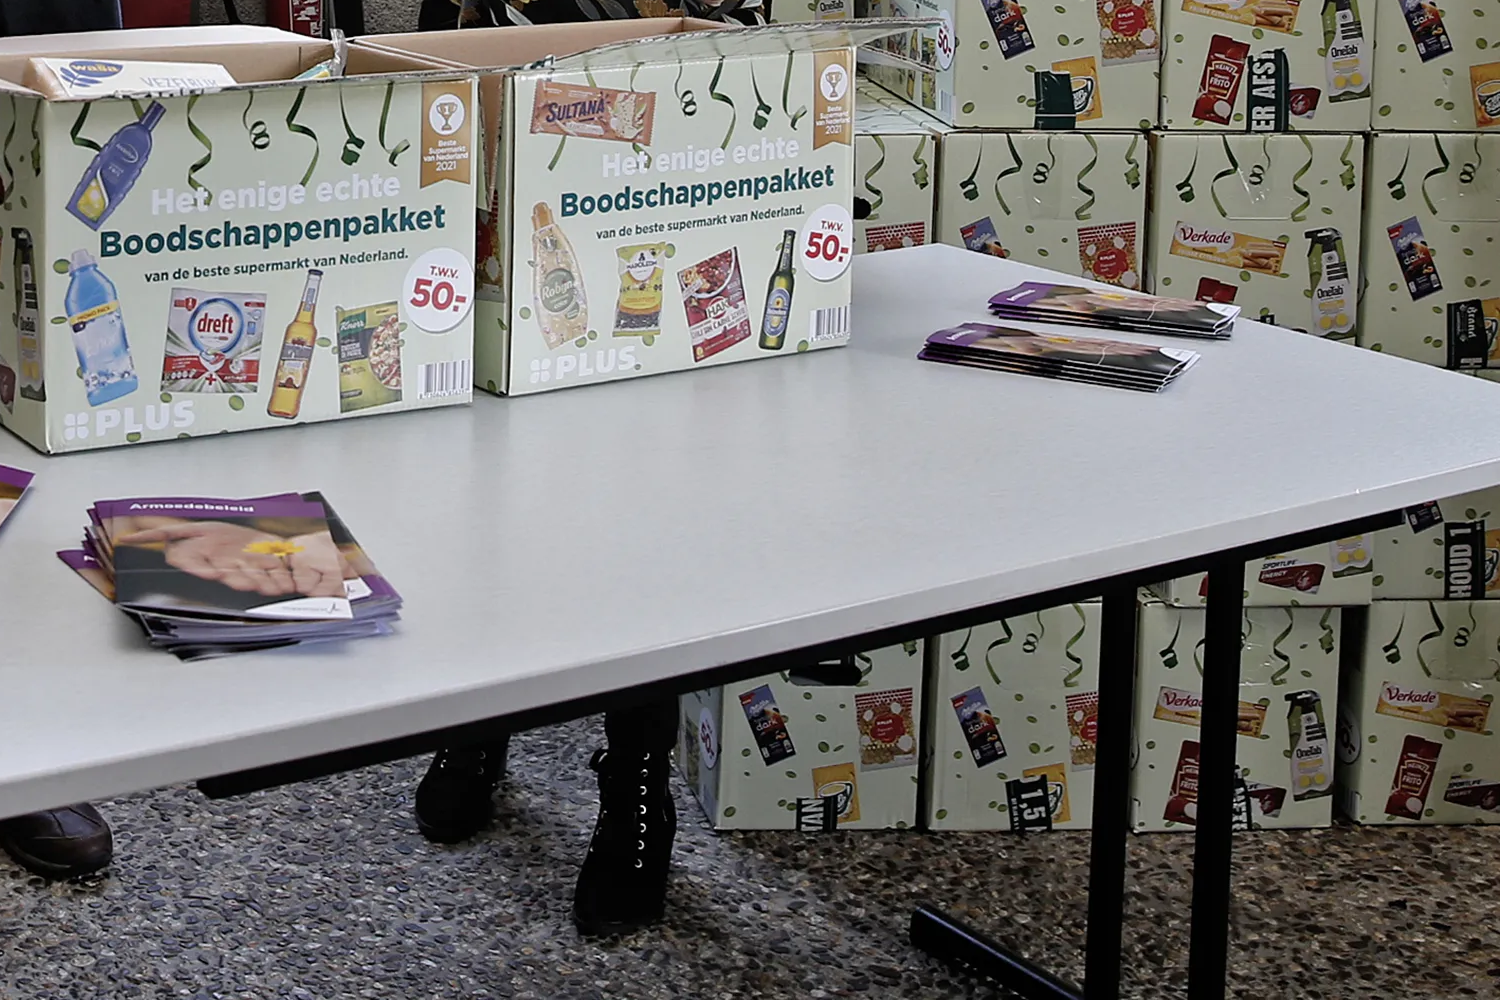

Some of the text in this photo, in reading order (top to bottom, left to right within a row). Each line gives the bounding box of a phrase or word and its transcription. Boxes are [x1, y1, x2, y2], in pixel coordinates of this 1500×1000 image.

[819, 0, 845, 12] OneTab
[993, 8, 1017, 23] dark
[1411, 12, 1435, 27] dark
[1331, 44, 1359, 58] OneTab
[1209, 76, 1231, 89] FRITO
[546, 98, 605, 122] SULTANA
[825, 125, 843, 135] 2021
[435, 160, 458, 171] 2021
[601, 135, 800, 179] Het enige echte
[152, 173, 401, 216] Het enige echte
[560, 164, 835, 218] Boodschappenpakket
[100, 204, 446, 258] Boodschappenpakket
[596, 205, 805, 240] van de beste supermarkt van Nederland.
[820, 220, 843, 232] T.W.V.
[1179, 226, 1231, 244] Verkade
[145, 248, 409, 283] van de beste supermarkt van Nederland.
[430, 265, 459, 279] T.W.V.
[542, 280, 573, 301] Robijn
[1316, 284, 1344, 298] OneTab
[707, 299, 731, 318] HAK
[197, 312, 234, 334] dreft
[555, 345, 636, 380] PLUS
[95, 400, 196, 438] PLUS
[129, 502, 255, 514] Armoedebeleid
[1449, 544, 1472, 598] HOUD
[1385, 687, 1437, 704] Verkade
[756, 717, 778, 731] dark
[968, 720, 990, 733] dark
[1296, 745, 1323, 758] OneTab
